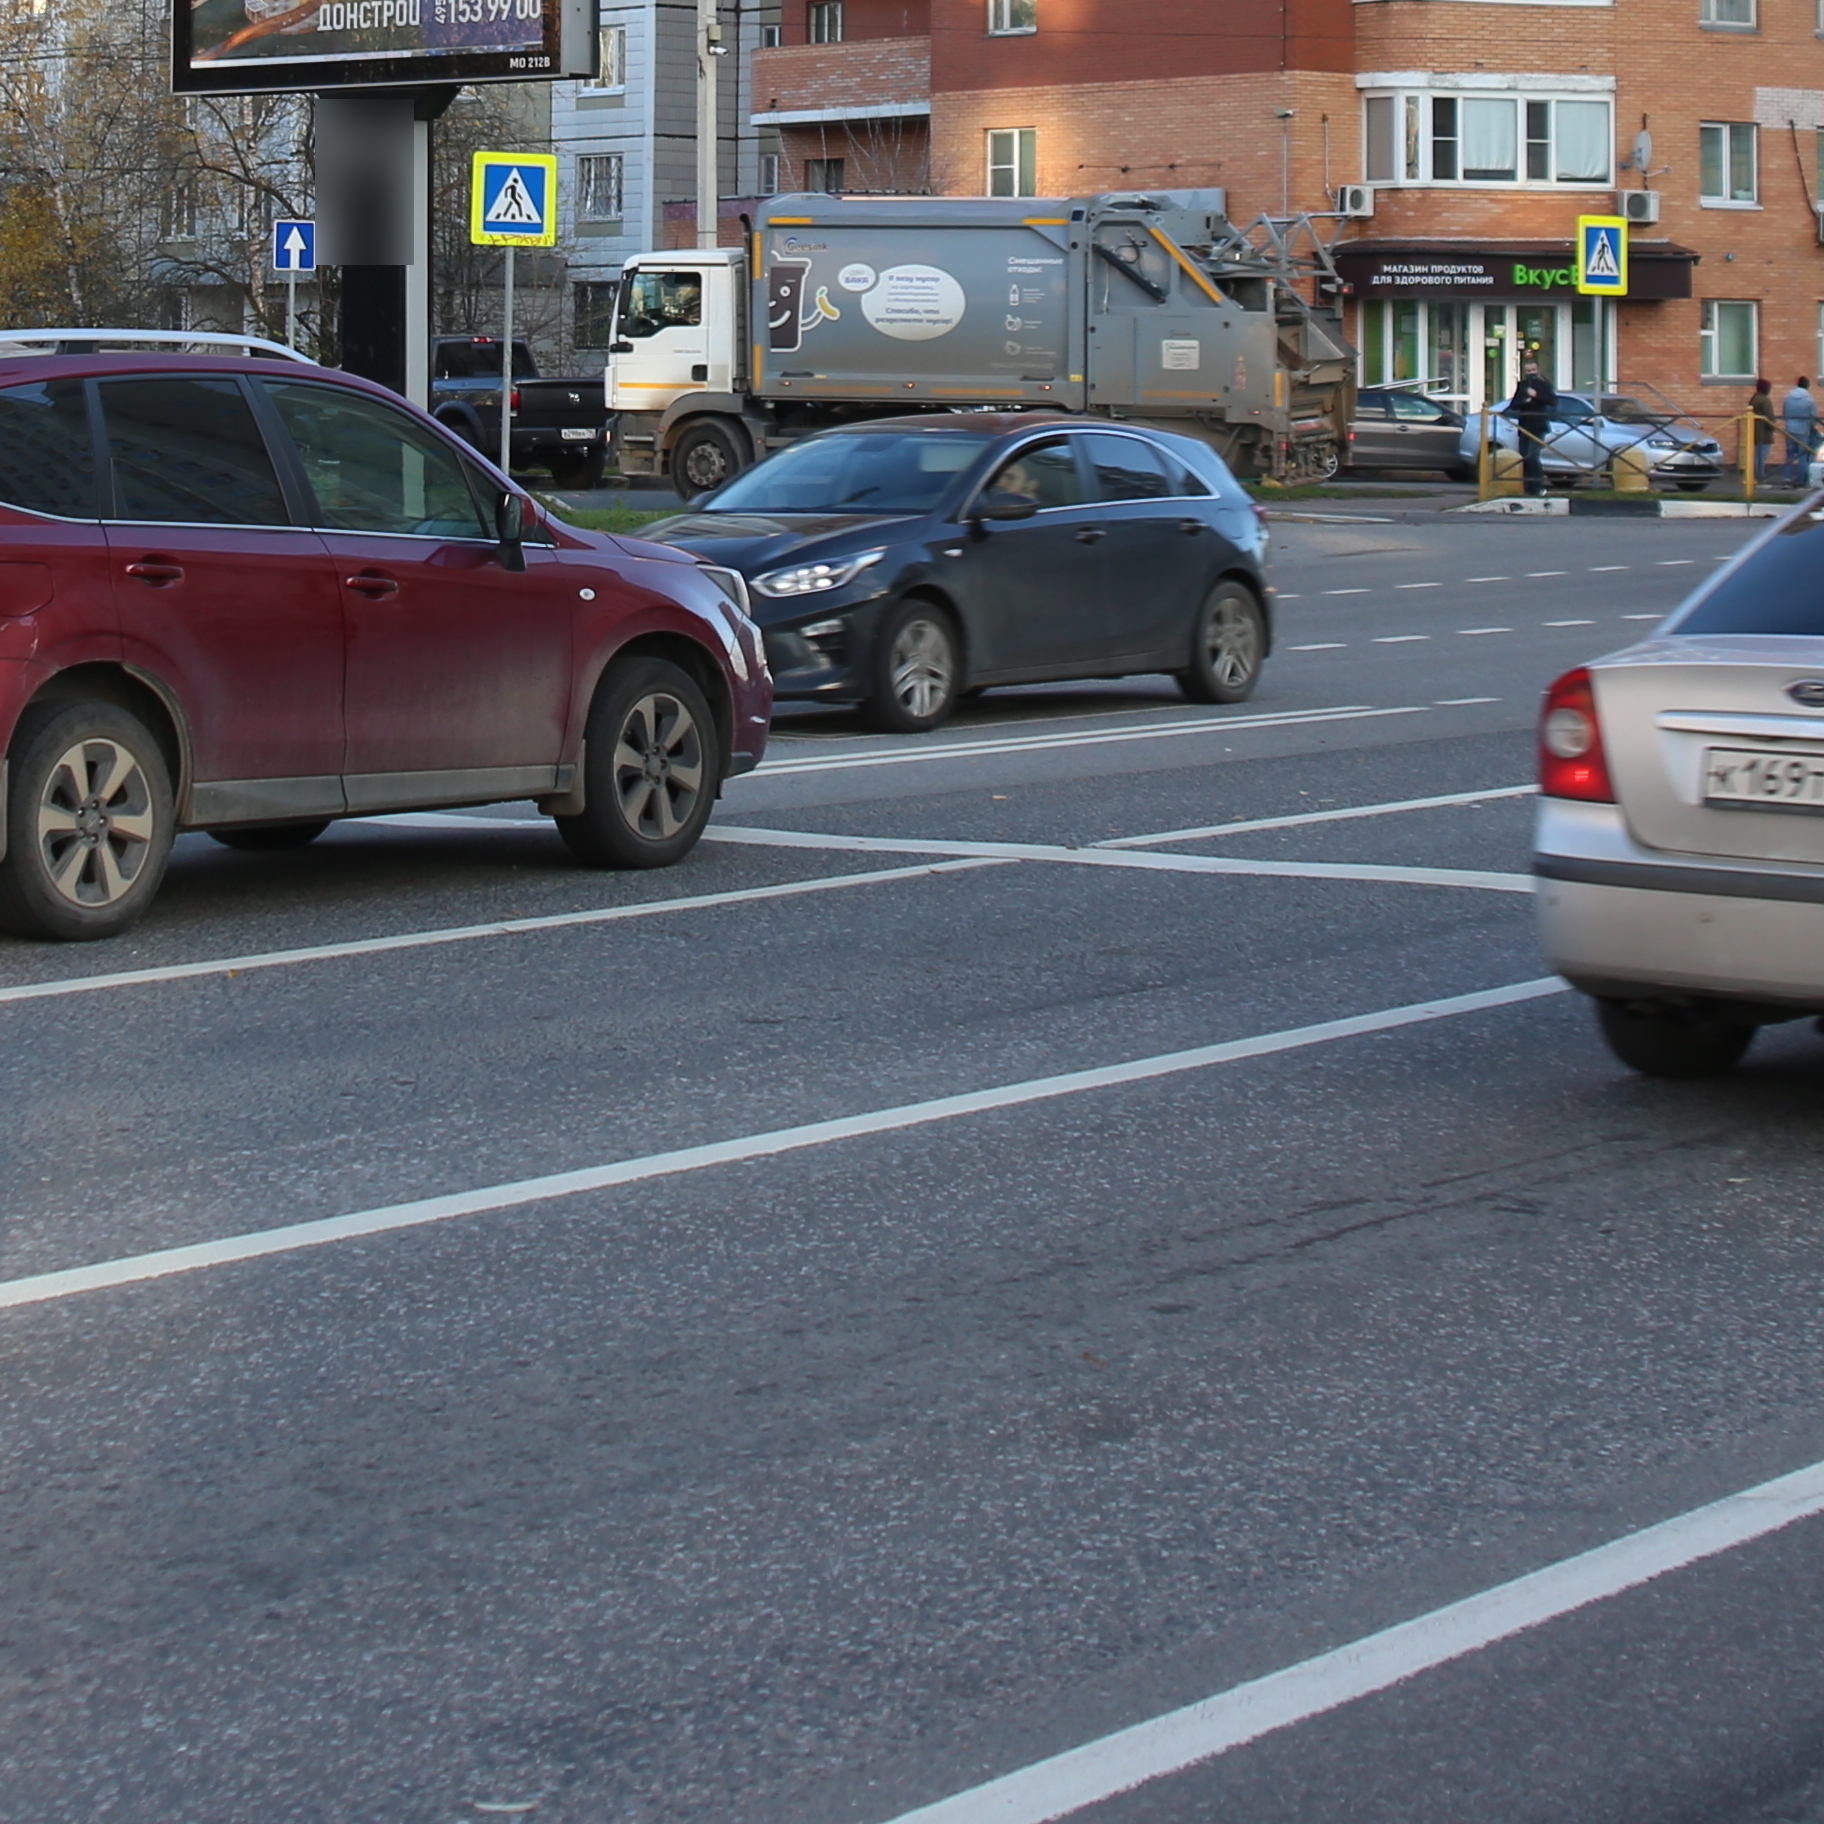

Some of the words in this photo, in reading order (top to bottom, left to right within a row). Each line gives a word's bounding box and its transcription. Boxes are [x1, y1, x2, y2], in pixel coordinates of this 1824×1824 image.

[1383, 265, 1428, 274] МАГАЗИН
[1431, 265, 1484, 274] ПРОДУКТОВ
[1372, 276, 1392, 285] ДЛЯ
[1395, 276, 1452, 285] ЗДОРОВОГО
[1454, 276, 1494, 285] ПИТАНИЯ
